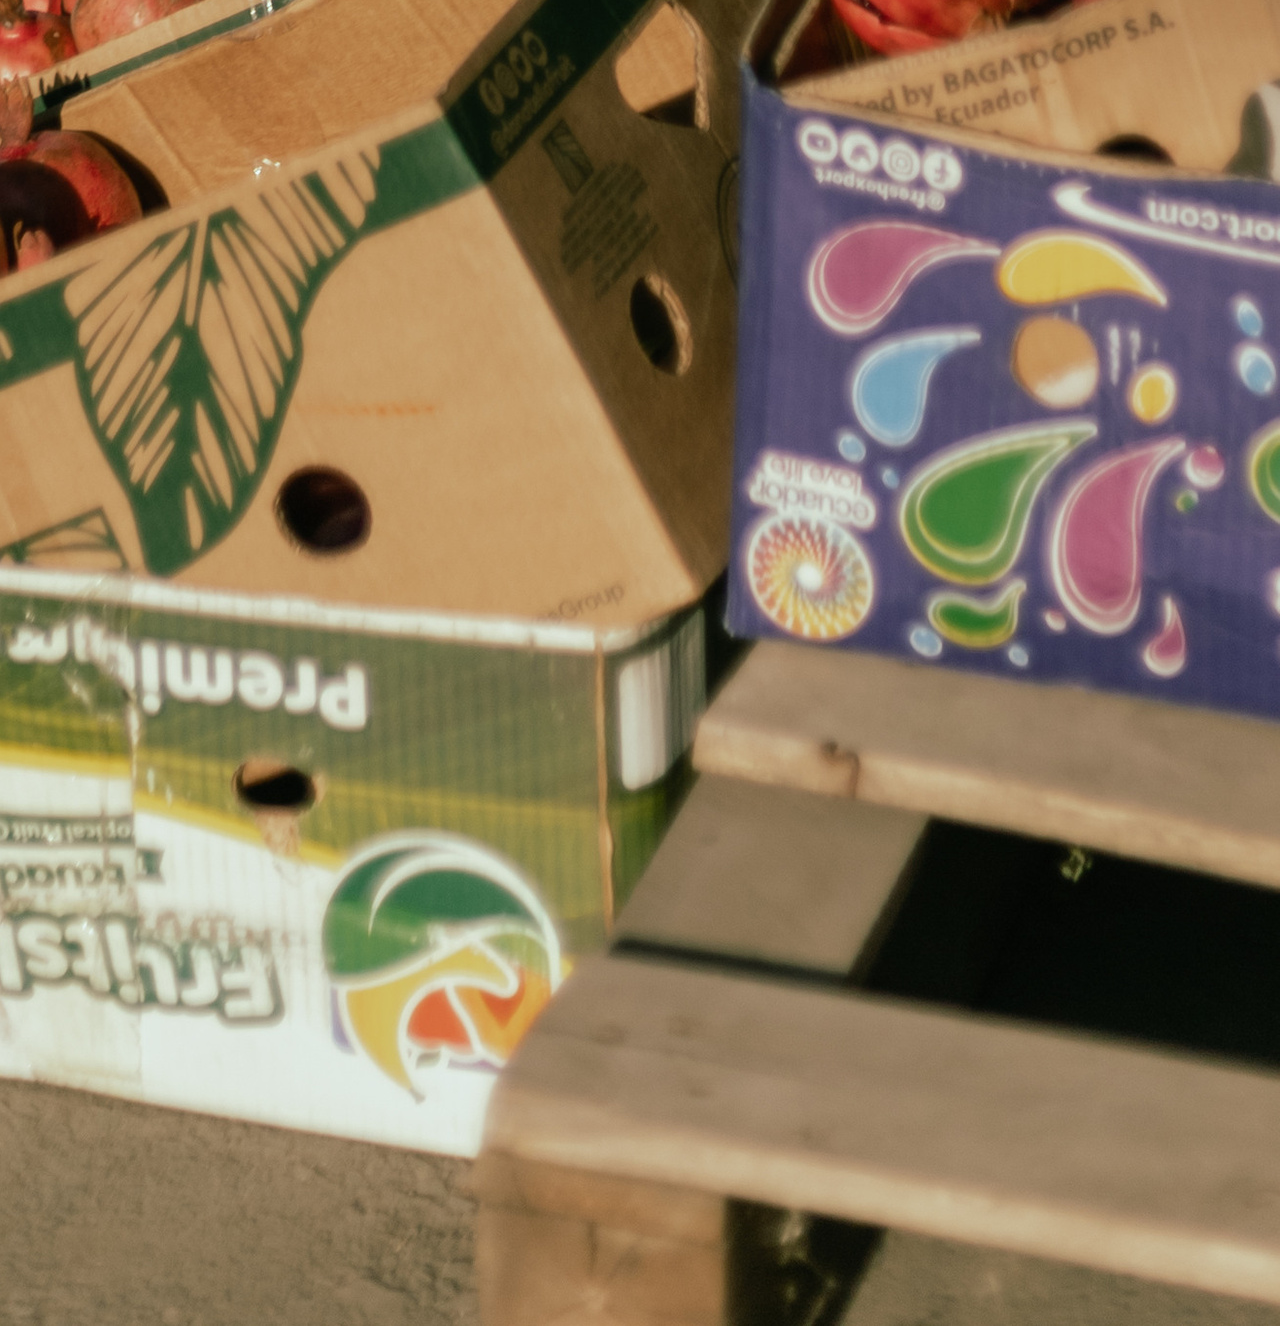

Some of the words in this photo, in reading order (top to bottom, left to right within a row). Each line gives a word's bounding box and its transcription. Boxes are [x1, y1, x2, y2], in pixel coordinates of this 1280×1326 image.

[902, 82, 935, 107] by
[942, 24, 1117, 95] BAGATOCORP
[1122, 10, 1176, 41] S.A.
[935, 84, 1040, 125] Ecuador
[1146, 196, 1280, 243] ort.com
